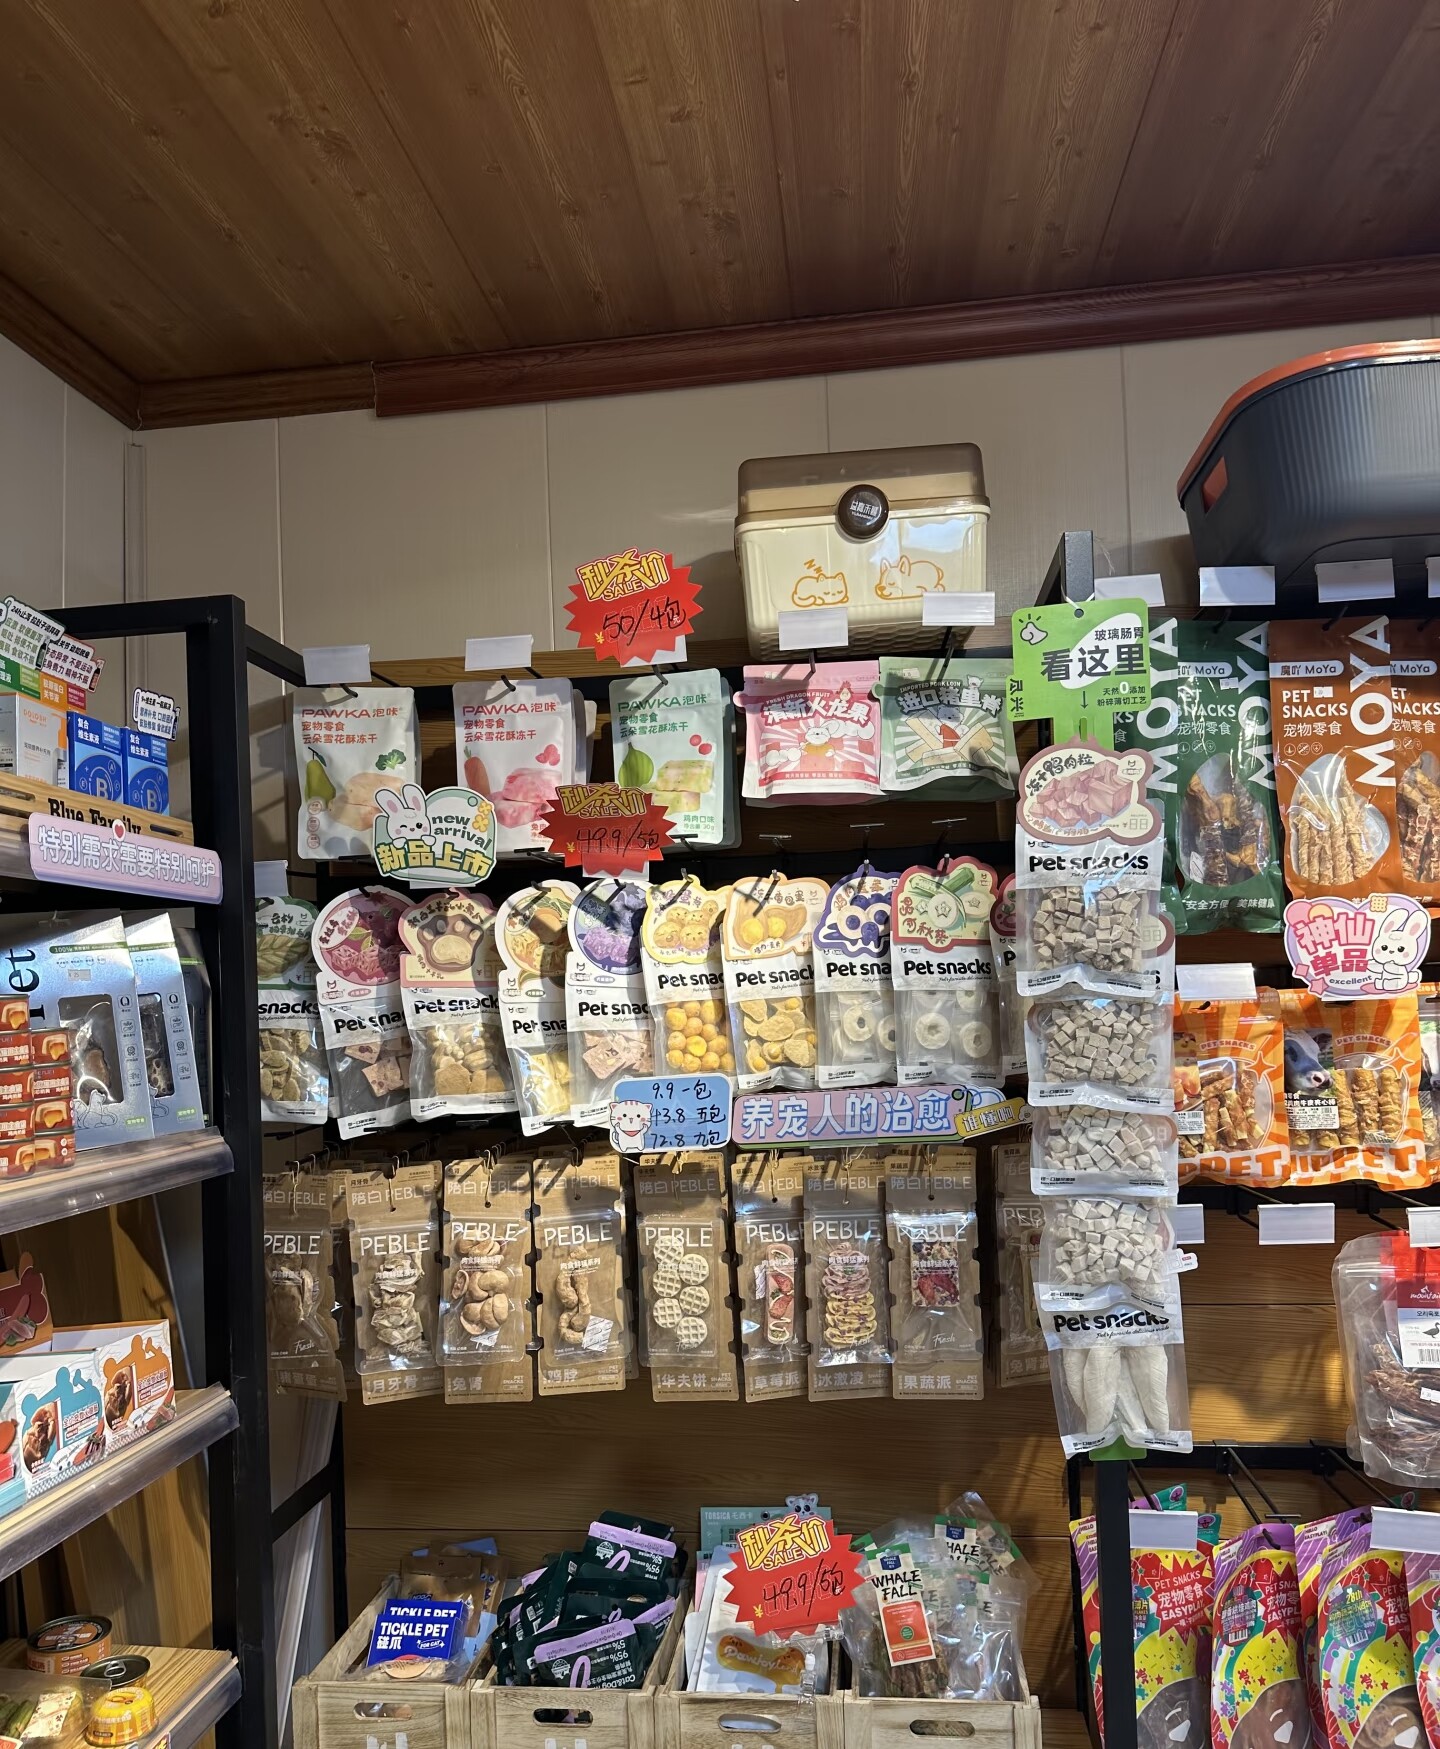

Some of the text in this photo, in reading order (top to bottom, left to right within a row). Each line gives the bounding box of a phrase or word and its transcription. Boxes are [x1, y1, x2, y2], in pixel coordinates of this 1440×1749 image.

[604, 581, 643, 599] SALE
[1095, 627, 1144, 641] 玻璃肠胃
[1040, 643, 1147, 682] 看这里
[1305, 664, 1336, 675] MoYa
[1097, 696, 1147, 707] 粉碎薄切工艺
[1282, 690, 1310, 703] PET
[1348, 614, 1396, 787] MOYA
[462, 702, 529, 716] PAWKA
[618, 697, 681, 713] PAWKA
[1282, 702, 1348, 718] SNACKS
[302, 709, 370, 719] PAWKA
[619, 714, 658, 726] 宠物零食
[302, 721, 345, 731] 宠物零食
[464, 719, 505, 729] 宠物零食
[620, 723, 689, 737] 云朵雪花酥冻干
[1283, 720, 1342, 737] 宠物零食
[302, 734, 378, 745] 云朵雪花酥冻干
[464, 730, 537, 743] 云朵雪花酥冻干
[432, 814, 470, 826] new
[581, 807, 618, 818] SALE
[434, 827, 492, 851] arrival
[38, 825, 216, 887] 特别需求需要特别呵护
[377, 841, 493, 877] 新品上市
[1029, 852, 1149, 872] Pet snacks
[1295, 911, 1375, 955] 神仙
[827, 962, 857, 977] Pet
[904, 958, 991, 975] Pet snacks
[1311, 948, 1368, 977] 单品
[658, 975, 688, 989] Pet
[736, 971, 767, 987] Pet
[1329, 974, 1373, 985] excellent
[414, 1001, 445, 1015] Pet
[579, 1002, 609, 1016] Pet
[335, 1016, 367, 1034] Pet
[512, 1020, 539, 1034] Pet
[1200, 1039, 1255, 1051] PET SNACKS
[1336, 1034, 1392, 1047] PET SNACKS
[652, 1082, 674, 1100] 9.9
[742, 1089, 951, 1139] 养宠人的治愈
[962, 1105, 1014, 1132] 谁懂啊
[451, 1222, 520, 1241] PEBLE
[544, 1222, 613, 1247] PEBLE
[812, 1220, 880, 1241] PEBLE
[263, 1235, 321, 1255] PEBLE
[360, 1232, 430, 1256] PEBLE
[1054, 1313, 1093, 1332] Pet
[373, 1375, 419, 1393] 月牙骨
[453, 1376, 483, 1391] 兔肾
[661, 1373, 708, 1388] 华夫饼
[754, 1372, 800, 1389] 草莓派
[818, 1371, 864, 1387] 冰激凌
[904, 1375, 952, 1390] 果蔬派
[763, 1548, 803, 1568] SALE
[871, 1569, 921, 1588] WHALE
[1154, 1570, 1201, 1591] PET SNACKS
[882, 1585, 918, 1600] FALL
[1157, 1582, 1203, 1609] 宠物零食
[380, 1622, 449, 1638] TICKLE PET
